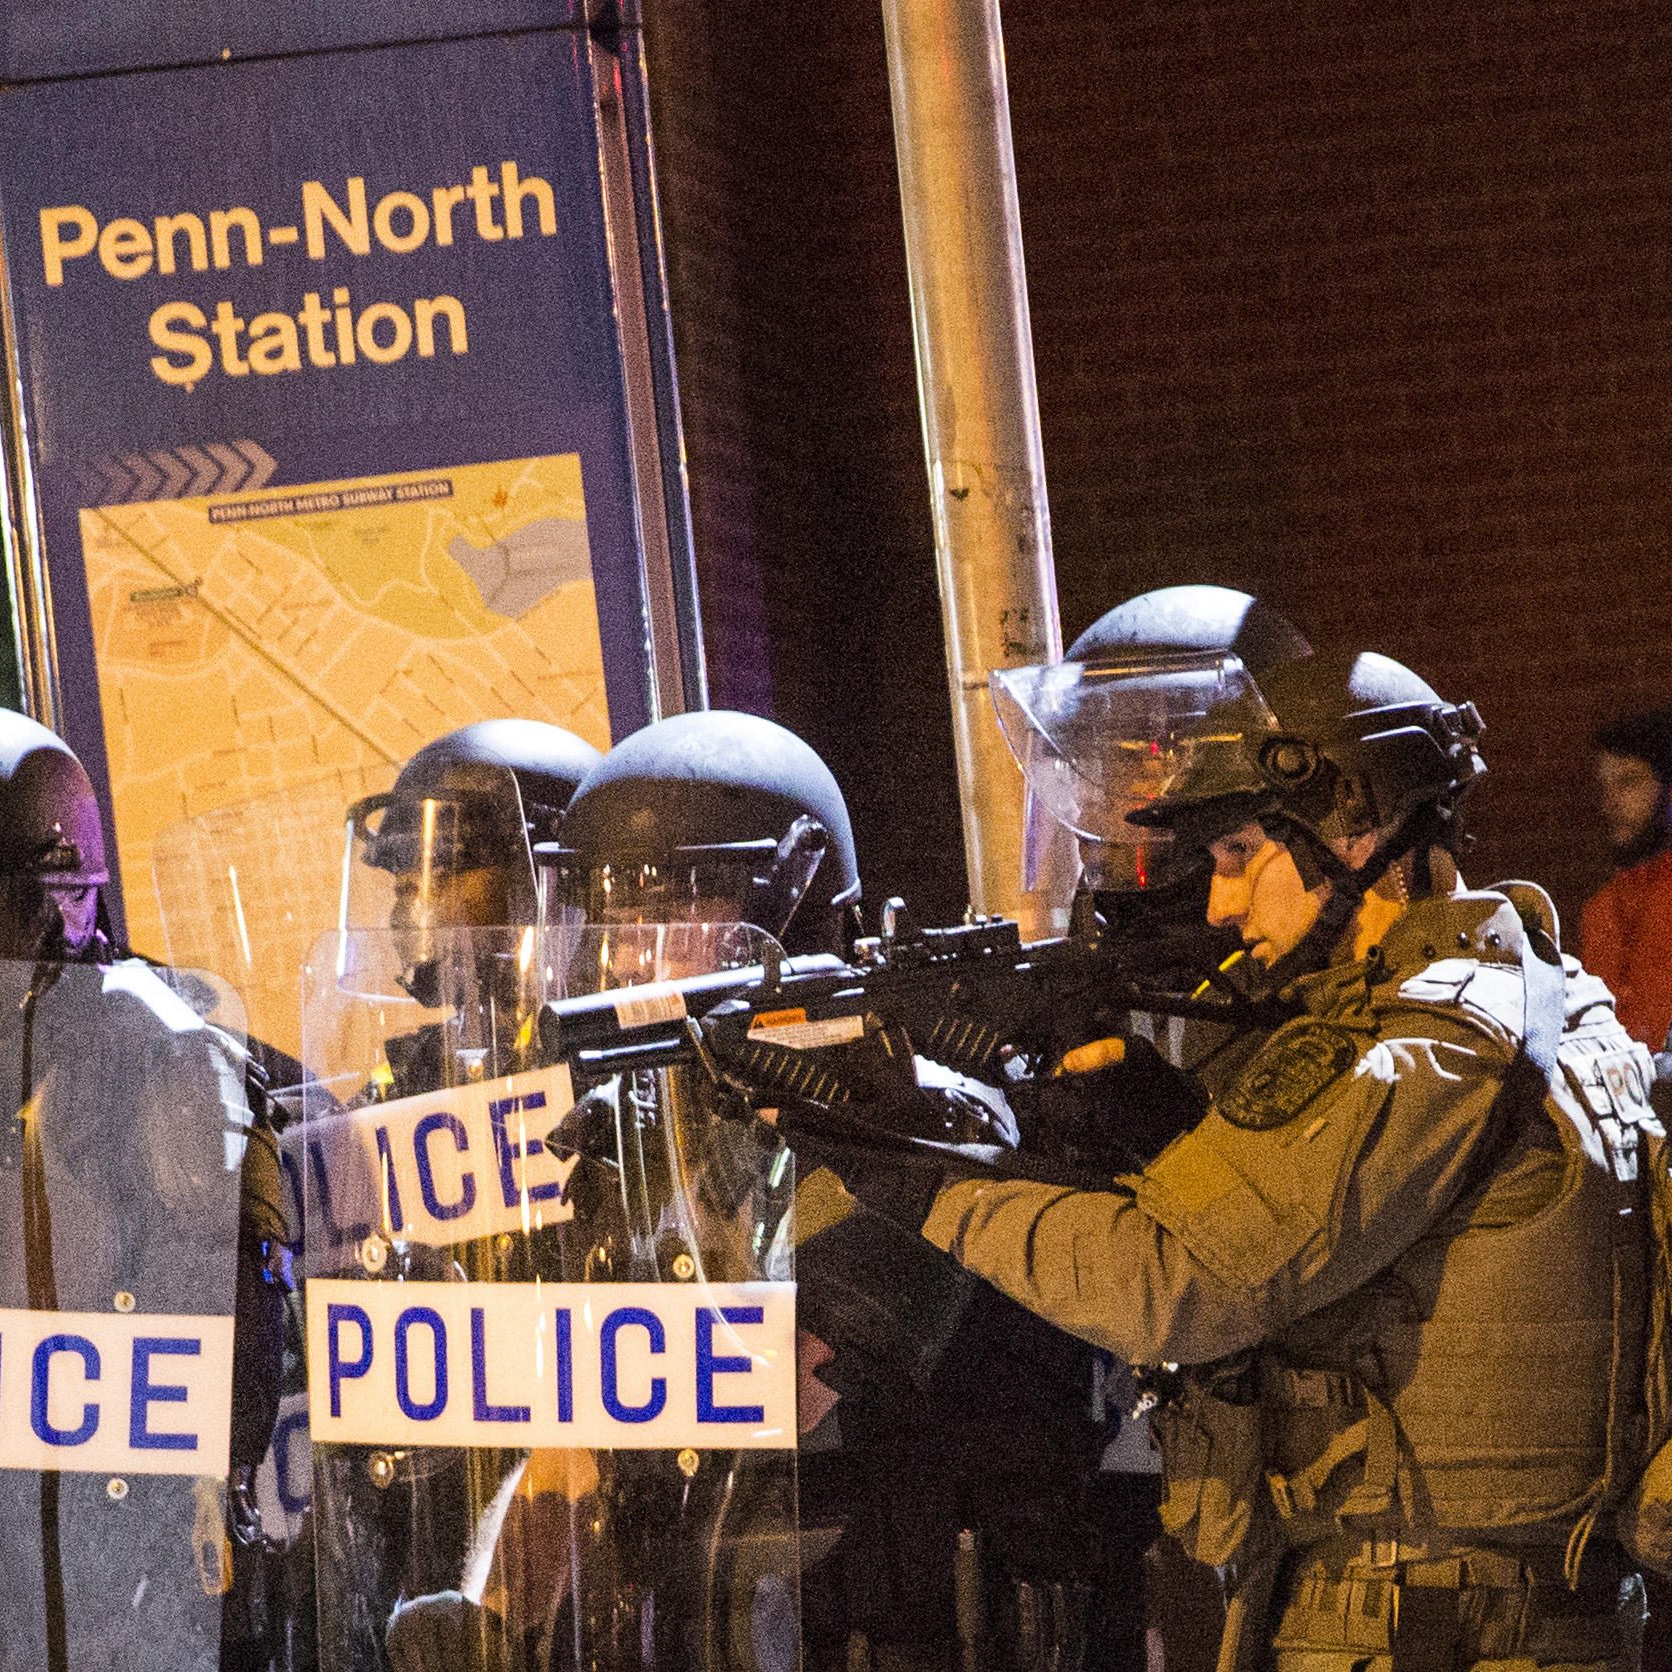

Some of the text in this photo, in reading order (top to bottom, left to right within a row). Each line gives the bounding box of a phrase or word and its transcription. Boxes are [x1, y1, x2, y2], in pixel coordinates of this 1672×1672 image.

[39, 160, 558, 287] Penn-North
[148, 286, 469, 387] Station
[296, 495, 340, 513] METRO
[341, 488, 394, 508] SUBWAY
[395, 482, 451, 501] STATION
[327, 1302, 766, 1424] POLICE
